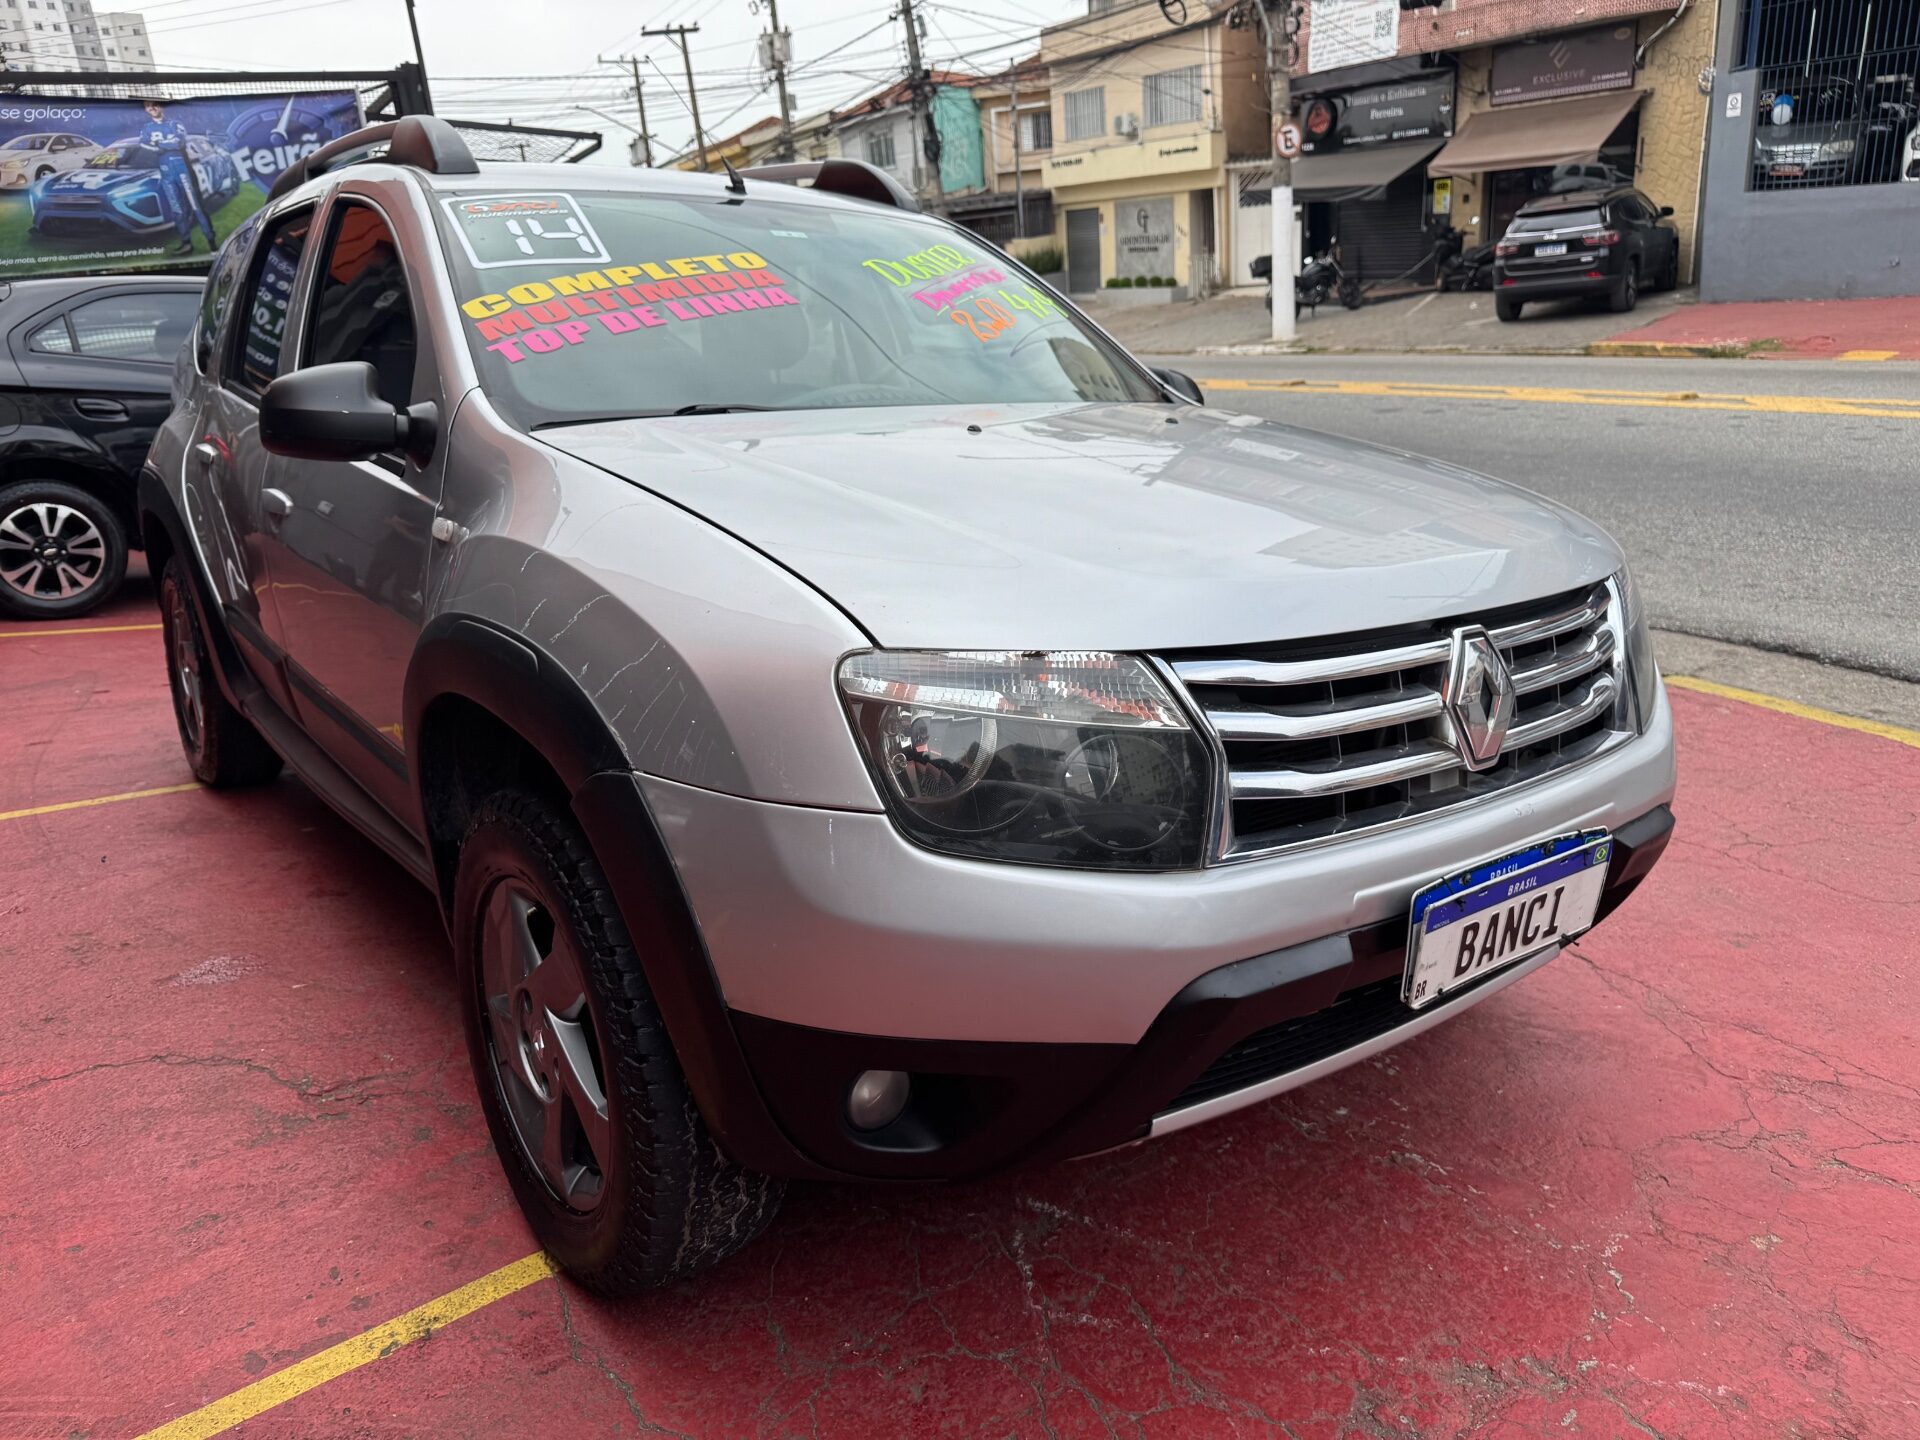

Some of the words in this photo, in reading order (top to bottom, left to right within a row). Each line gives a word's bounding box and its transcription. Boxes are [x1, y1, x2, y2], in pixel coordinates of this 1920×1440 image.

[1532, 68, 1586, 85] EXCLUSIVE
[23, 105, 87, 123] golaço:
[231, 132, 321, 182] Feirã
[467, 208, 569, 219] multimarcas
[505, 216, 596, 256] 14
[106, 251, 122, 259] vem
[123, 250, 138, 258] pra
[461, 251, 768, 320] COMPLETO
[475, 268, 785, 342] MULTIMIDIA
[485, 320, 592, 363] TOP
[597, 304, 669, 335] DE
[663, 287, 801, 322] LINHA
[1507, 876, 1538, 896] BRASIL
[1454, 885, 1566, 978] BANCI
[1414, 979, 1428, 1001] BR
